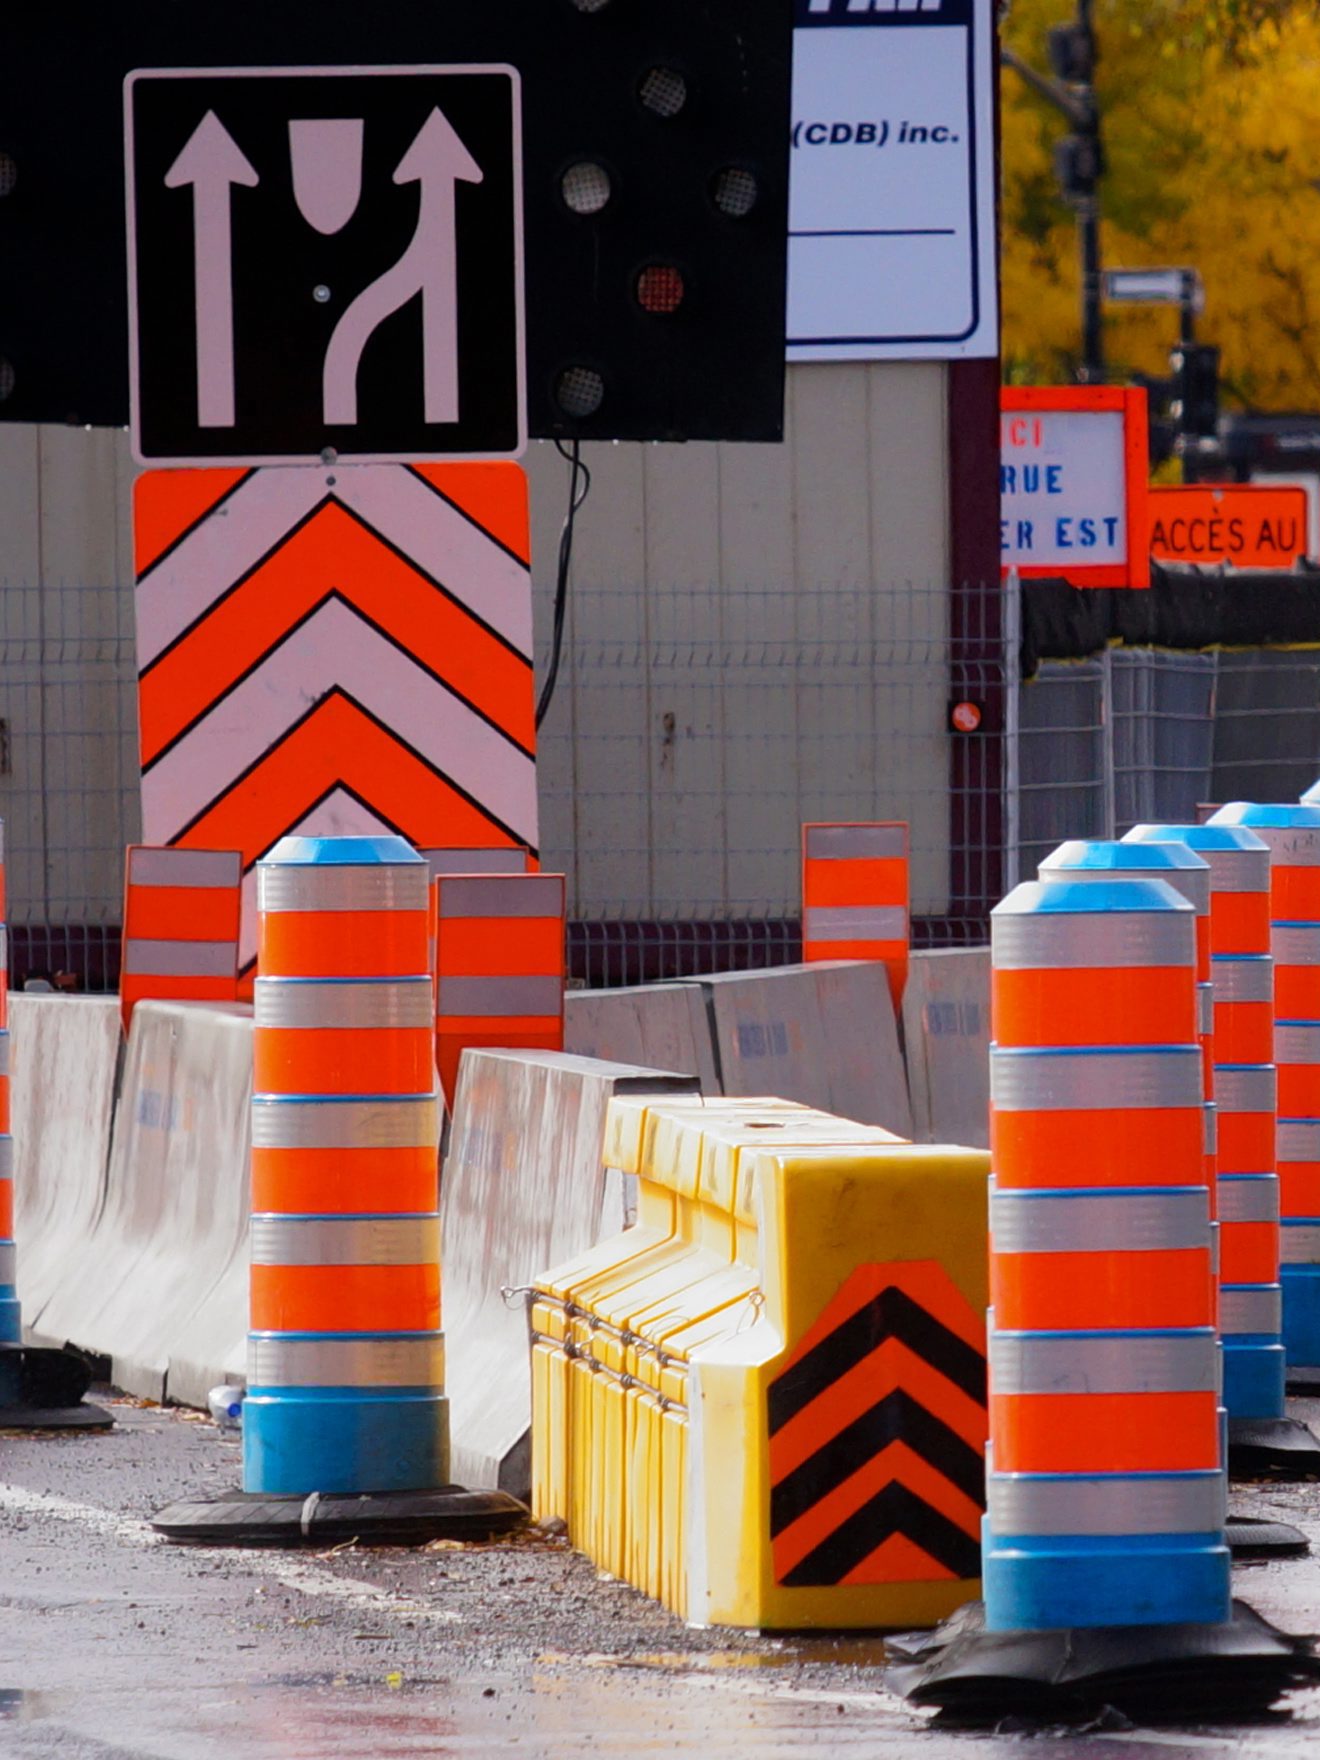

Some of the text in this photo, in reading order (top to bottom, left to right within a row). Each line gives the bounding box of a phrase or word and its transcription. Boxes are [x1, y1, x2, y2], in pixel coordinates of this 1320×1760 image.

[793, 120, 959, 149] (CDB) inc.
[1000, 465, 1062, 494] RUE
[1056, 516, 1118, 547] EST
[1150, 507, 1297, 552] ACCÈS AU
